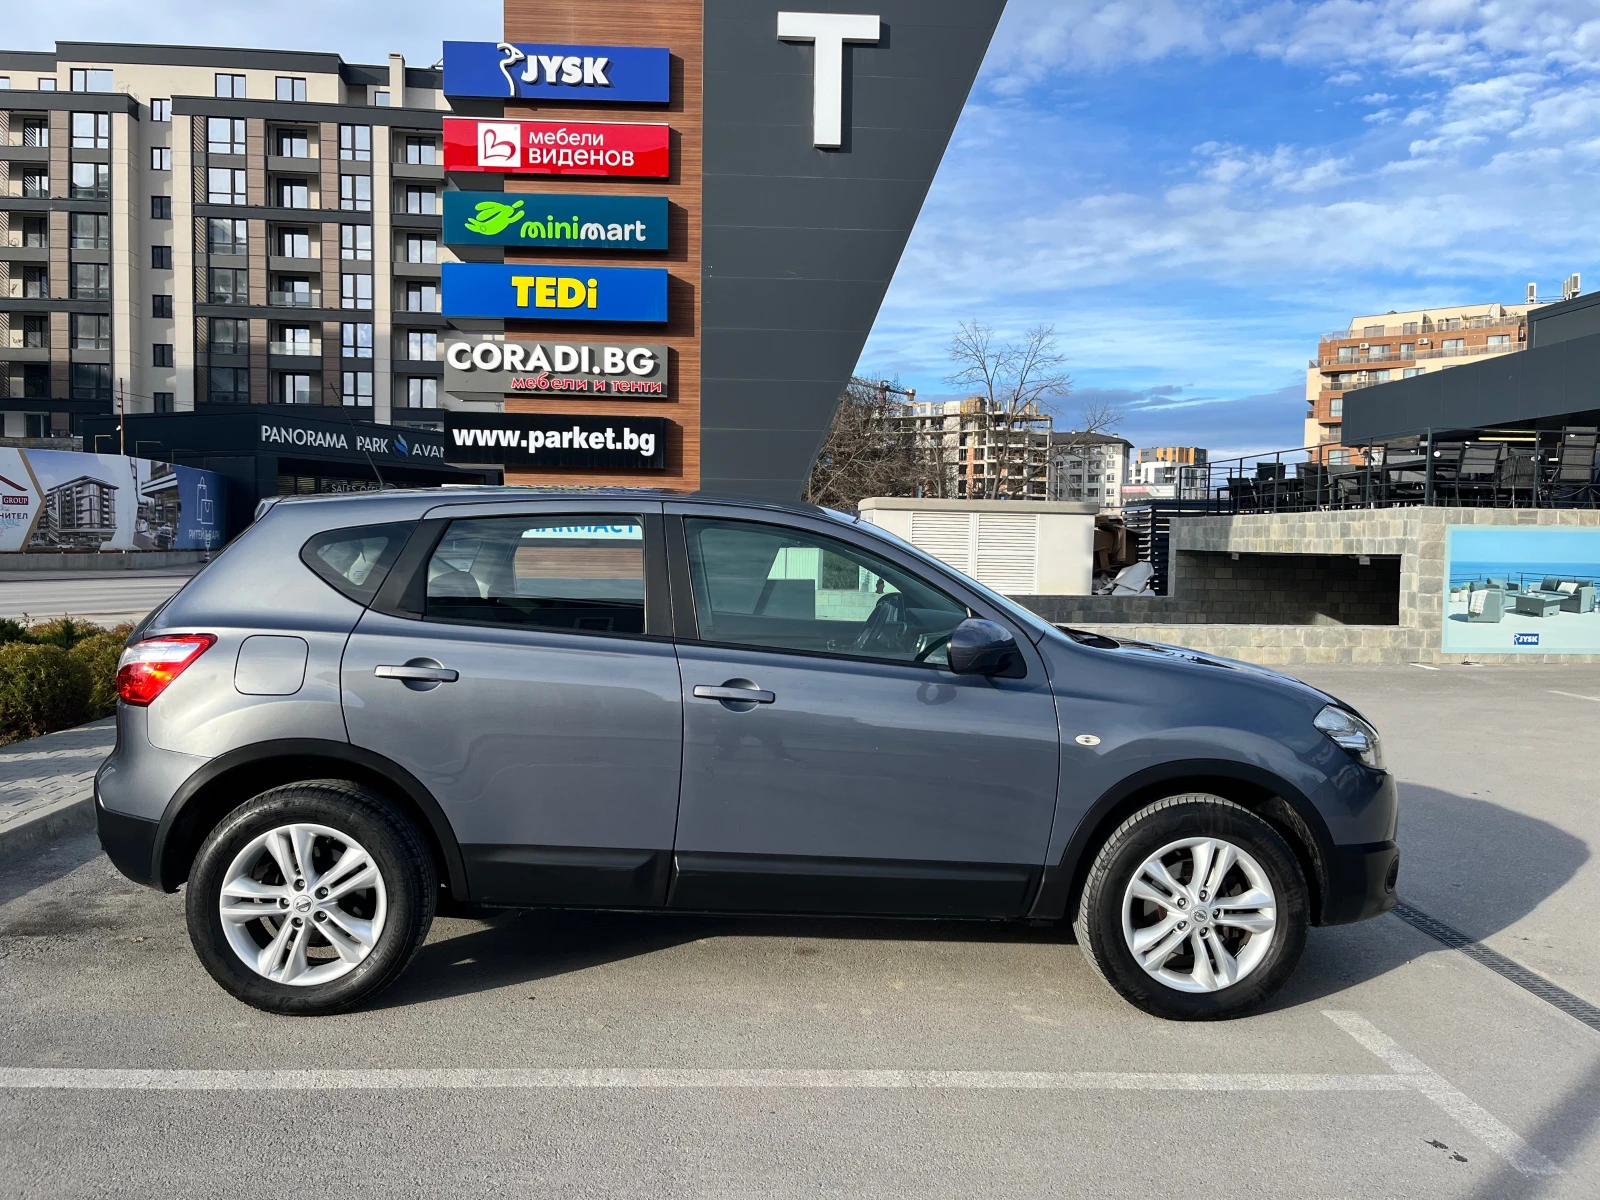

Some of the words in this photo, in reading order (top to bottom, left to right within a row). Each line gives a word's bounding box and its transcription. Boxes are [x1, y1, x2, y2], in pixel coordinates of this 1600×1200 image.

[520, 55, 610, 85] JYSK
[777, 12, 880, 148] T
[528, 128, 604, 146] мебели
[520, 215, 646, 241] minimart
[511, 275, 598, 309] TEDi
[447, 342, 655, 375] CORADI.BG
[511, 372, 588, 391] мебели
[594, 380, 605, 392] и
[612, 380, 662, 393] тенти
[261, 425, 348, 449] PANORAMA
[356, 435, 389, 453] PARK
[452, 426, 655, 456] www.parket.bg
[1518, 635, 1538, 643] JYSK
